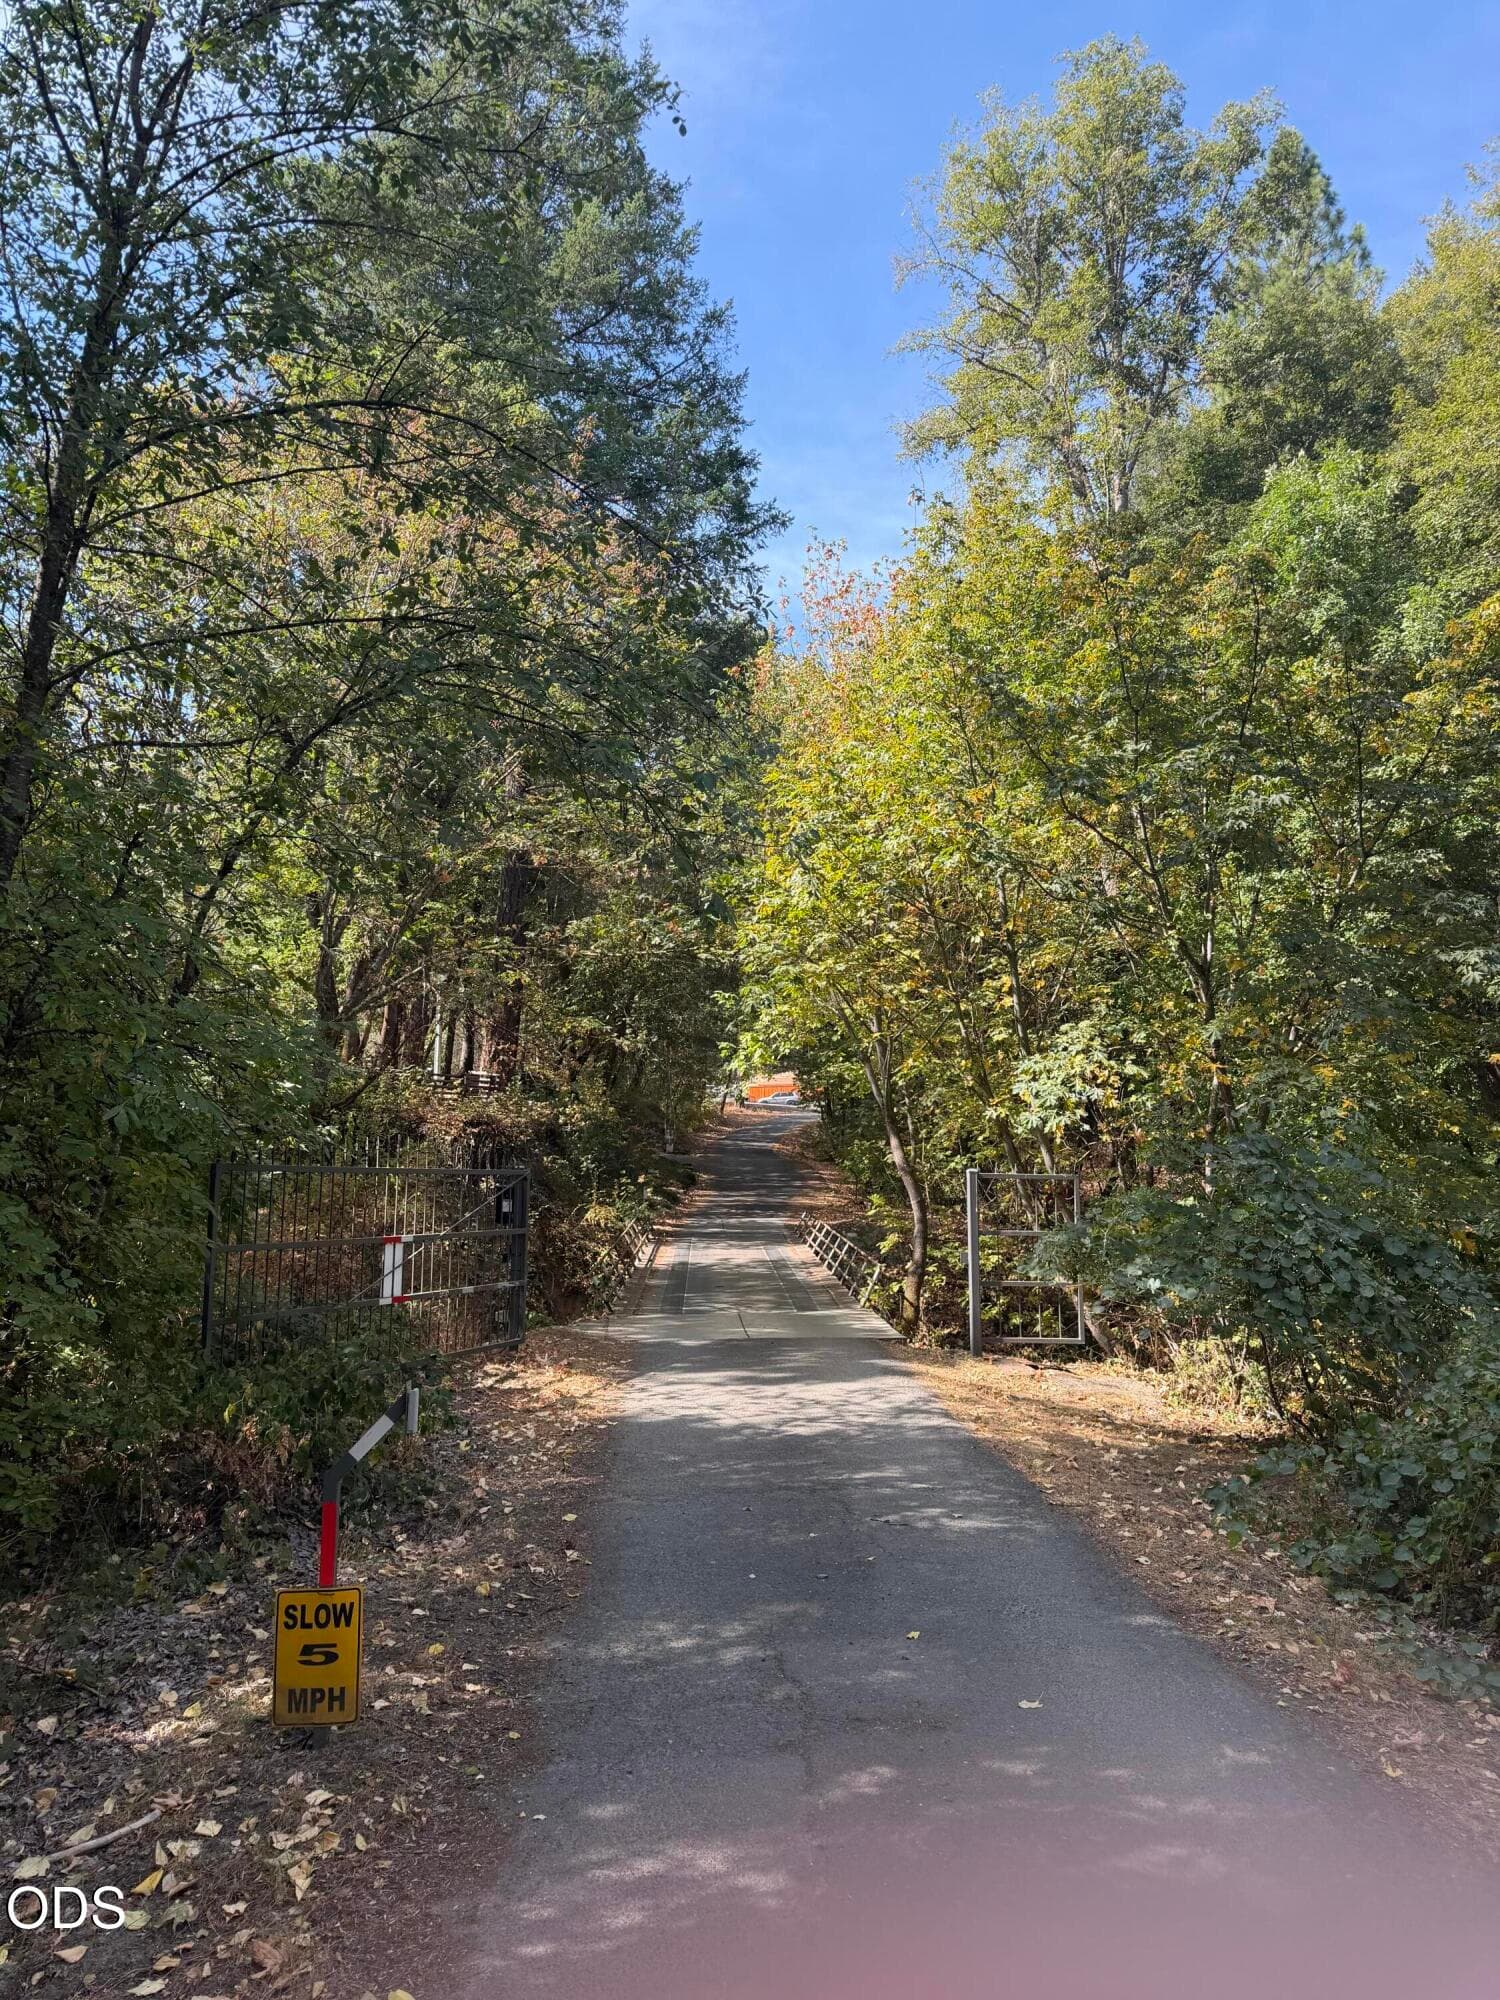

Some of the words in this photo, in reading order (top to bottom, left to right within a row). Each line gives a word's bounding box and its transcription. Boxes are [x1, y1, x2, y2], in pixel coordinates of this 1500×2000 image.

[283, 1602, 354, 1630] SLOW
[297, 1643, 339, 1666] 5
[287, 1687, 346, 1713] MPH
